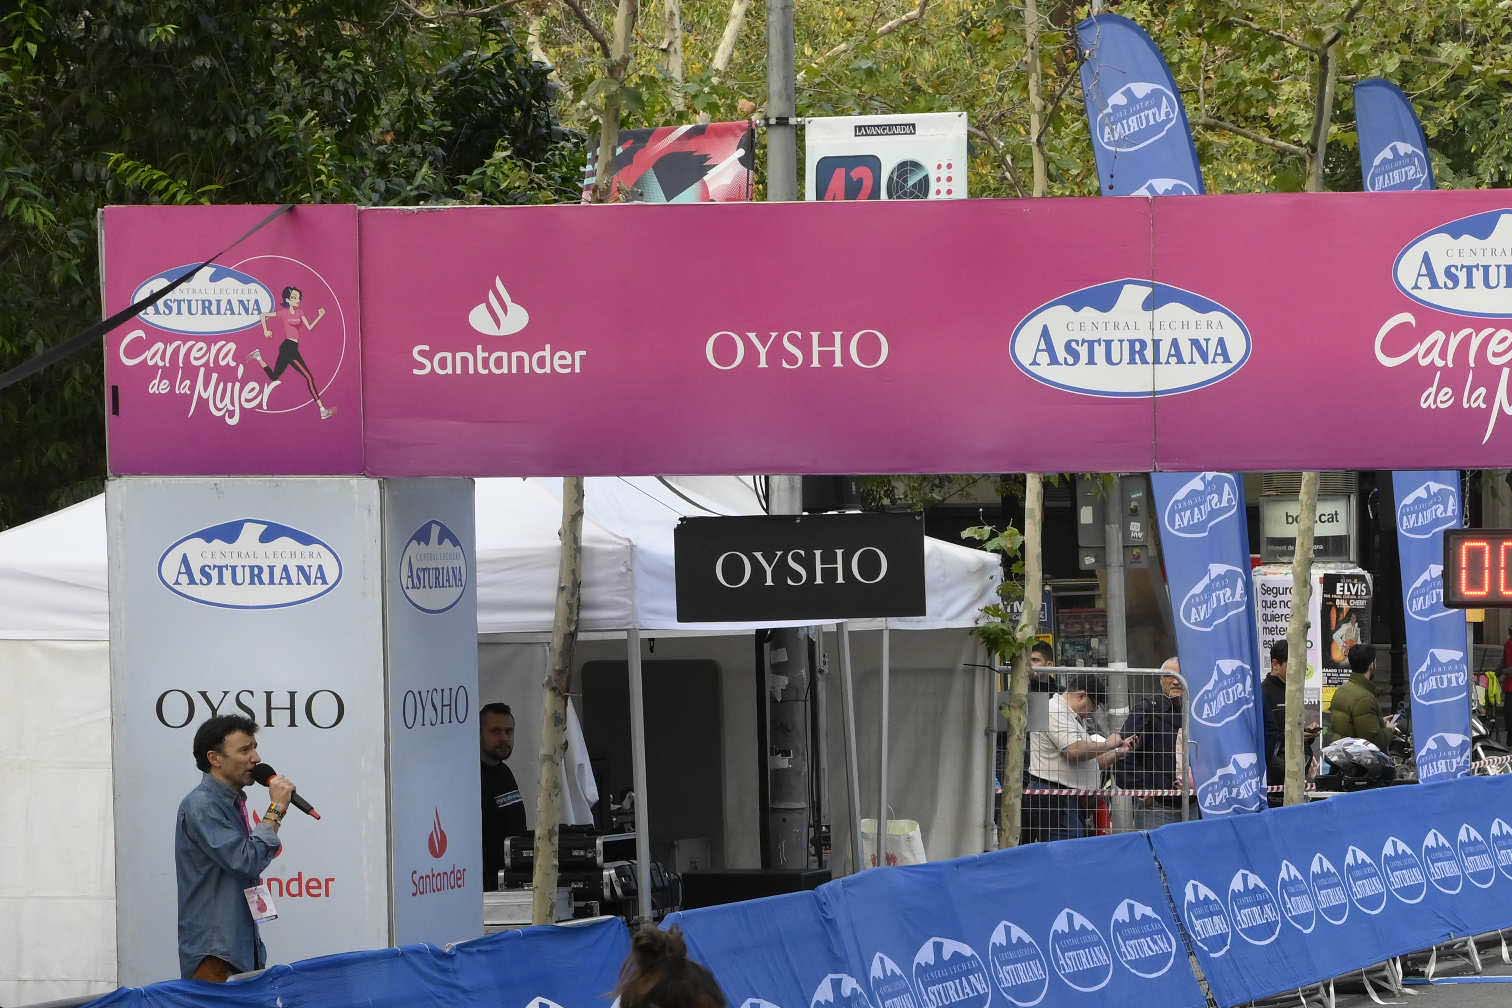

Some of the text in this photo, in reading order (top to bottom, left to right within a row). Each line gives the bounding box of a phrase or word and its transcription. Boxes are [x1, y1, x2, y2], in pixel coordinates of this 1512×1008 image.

[1066, 318, 1225, 332] CENTRAL LECHERA
[119, 330, 237, 367] Carrera
[411, 344, 587, 376] Santander
[705, 330, 890, 371] OYSHO
[1029, 323, 1232, 366] ASTURIANA
[149, 364, 282, 425] de la Mujer
[1420, 371, 1454, 410] de
[1463, 369, 1487, 410] la
[172, 552, 329, 586] ASTURIANA
[200, 550, 323, 560] CENTRAL LECHERA
[405, 555, 463, 590] ASTURIANA
[714, 546, 888, 588] OYSHO
[1261, 599, 1278, 612] que
[1336, 582, 1367, 595] ELVIS
[1261, 610, 1294, 625] quiere
[155, 689, 345, 729] OYSHO
[402, 685, 469, 729] OYSHO
[411, 864, 467, 897] Santander
